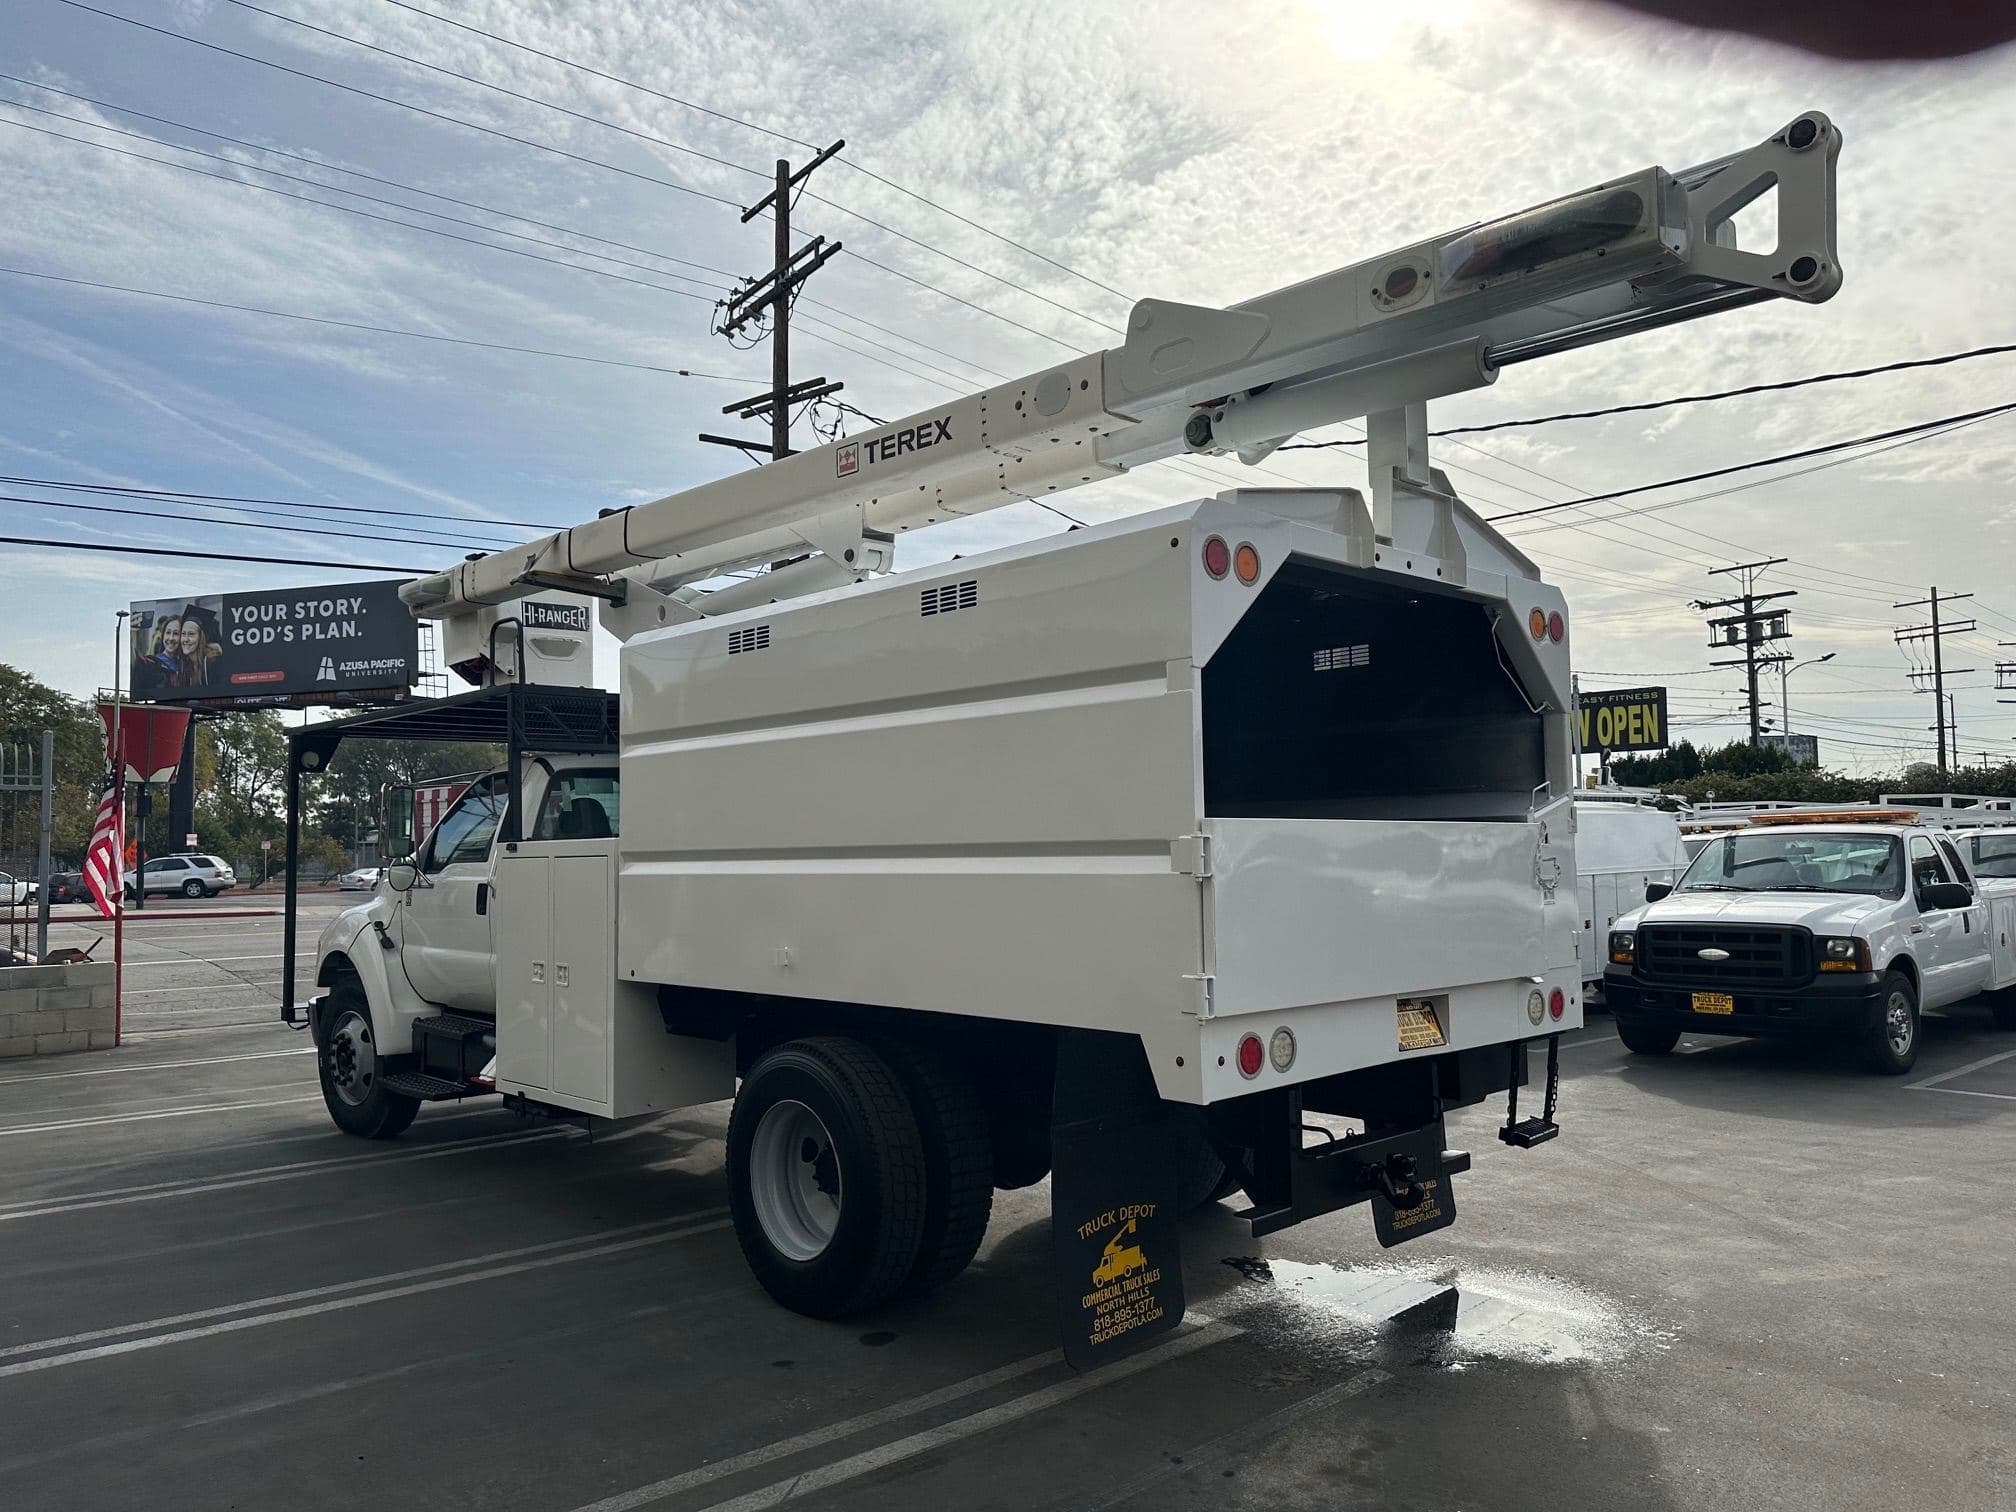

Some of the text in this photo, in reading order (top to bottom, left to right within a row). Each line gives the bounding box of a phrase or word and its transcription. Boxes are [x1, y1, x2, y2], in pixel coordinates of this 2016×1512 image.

[864, 416, 952, 464] TEREX
[231, 598, 367, 623] YOUR STORY.
[523, 602, 586, 630] HI-RANGER
[231, 621, 362, 645] GOD'S PLAN.
[339, 659, 405, 671] AZUSA PACIFIC
[345, 669, 398, 677] UNIVERSITY
[1609, 692, 1658, 702] FITNESS
[1597, 704, 1659, 746] OPEN
[1077, 1204, 1156, 1239] TRUCK DEPOT
[1082, 1268, 1160, 1308] COMMERCIAL TRUCK SALES
[1097, 1286, 1150, 1316] NORTH HILLS
[1089, 1306, 1163, 1346] TRUCKDEPOTLA.COM
[1094, 1296, 1155, 1332] 818-895-1377
